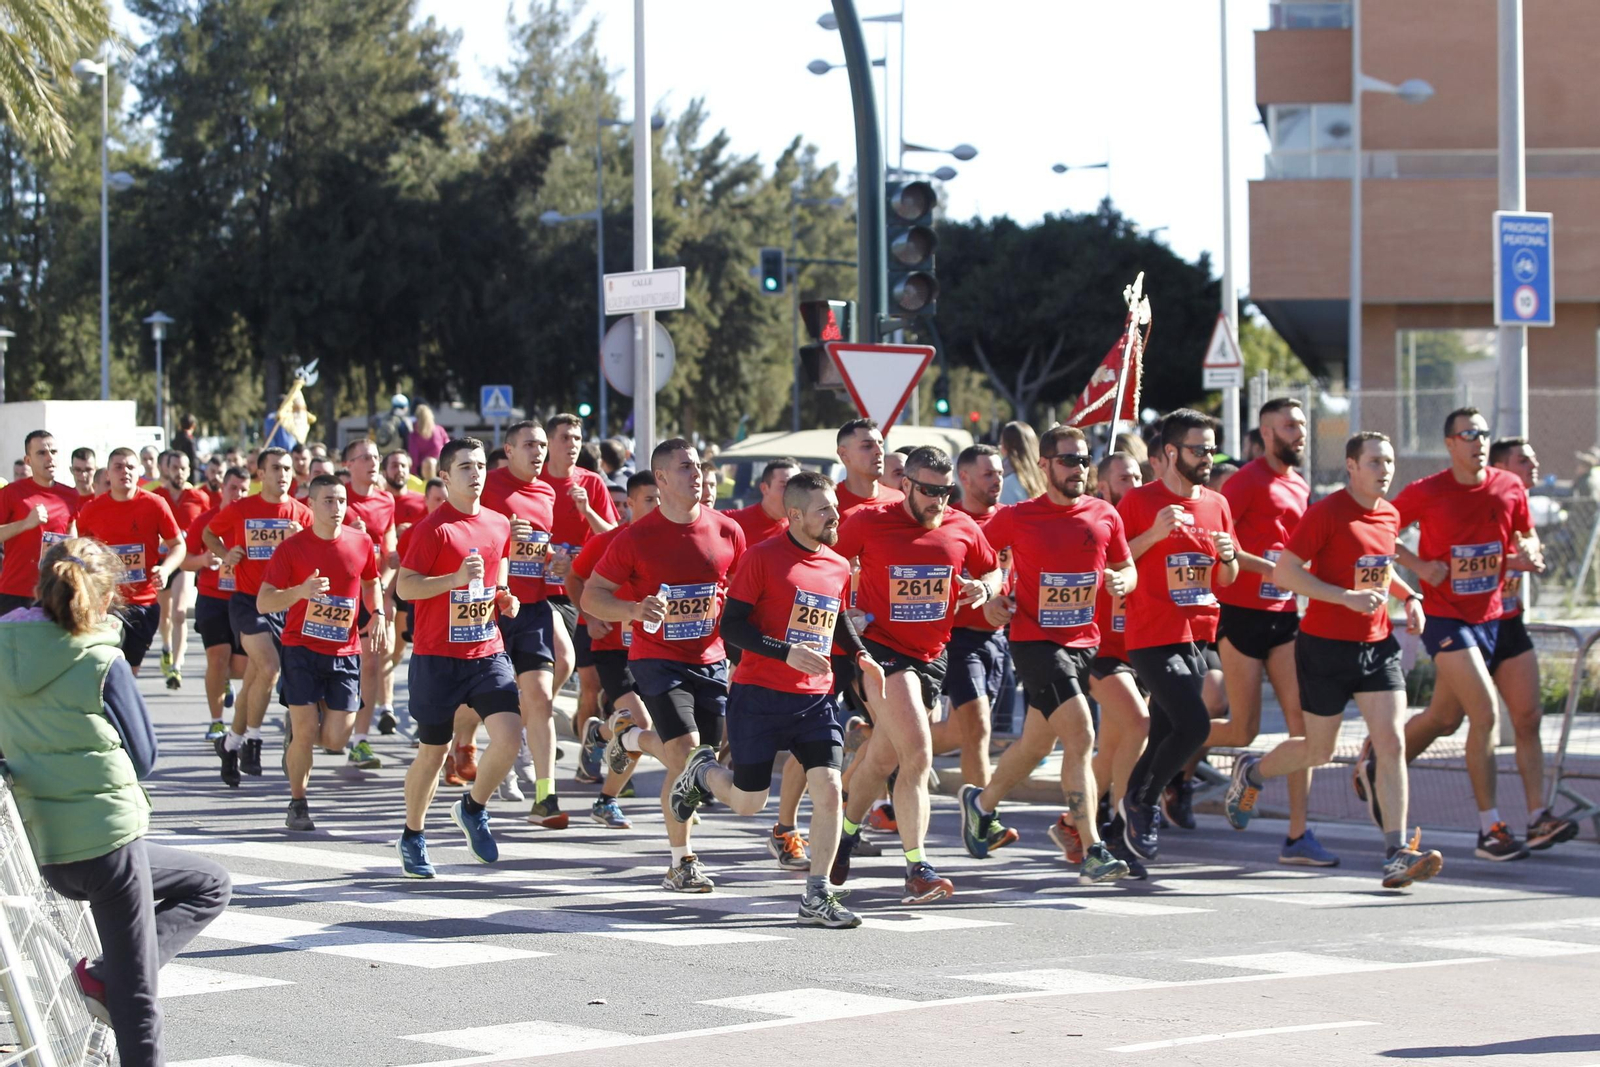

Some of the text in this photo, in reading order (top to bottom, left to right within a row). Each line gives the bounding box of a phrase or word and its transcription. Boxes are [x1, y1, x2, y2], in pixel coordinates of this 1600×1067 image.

[632, 277, 653, 287] CALLE
[251, 529, 285, 541] 2641
[516, 542, 548, 557] 2649
[1458, 555, 1497, 572] 2610
[897, 579, 944, 596] 2614
[1047, 586, 1092, 603] 2617
[312, 604, 351, 622] 2422
[668, 597, 711, 616] 2628
[797, 606, 835, 629] 2616
